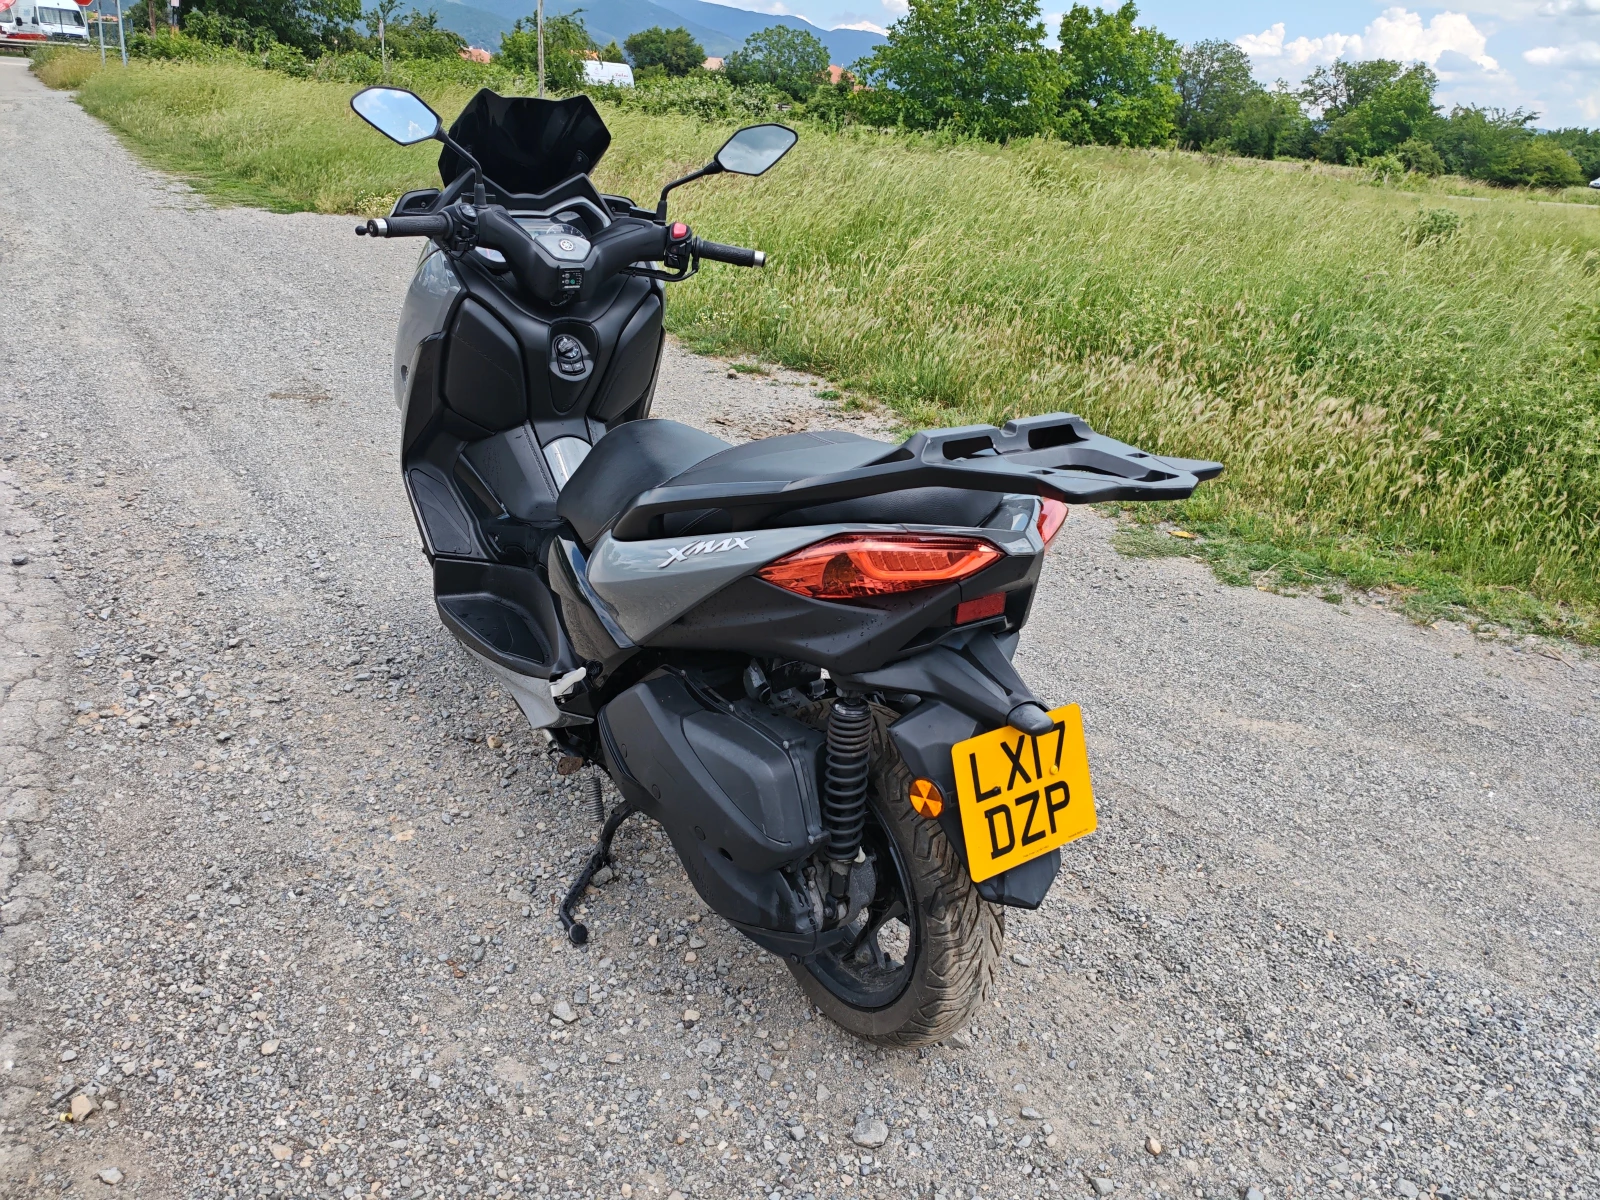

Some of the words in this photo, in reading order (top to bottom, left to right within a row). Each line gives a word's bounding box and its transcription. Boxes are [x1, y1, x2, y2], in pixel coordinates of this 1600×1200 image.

[657, 535, 757, 568] XMAX
[969, 720, 1066, 803] LX17
[984, 780, 1070, 859] DZP
